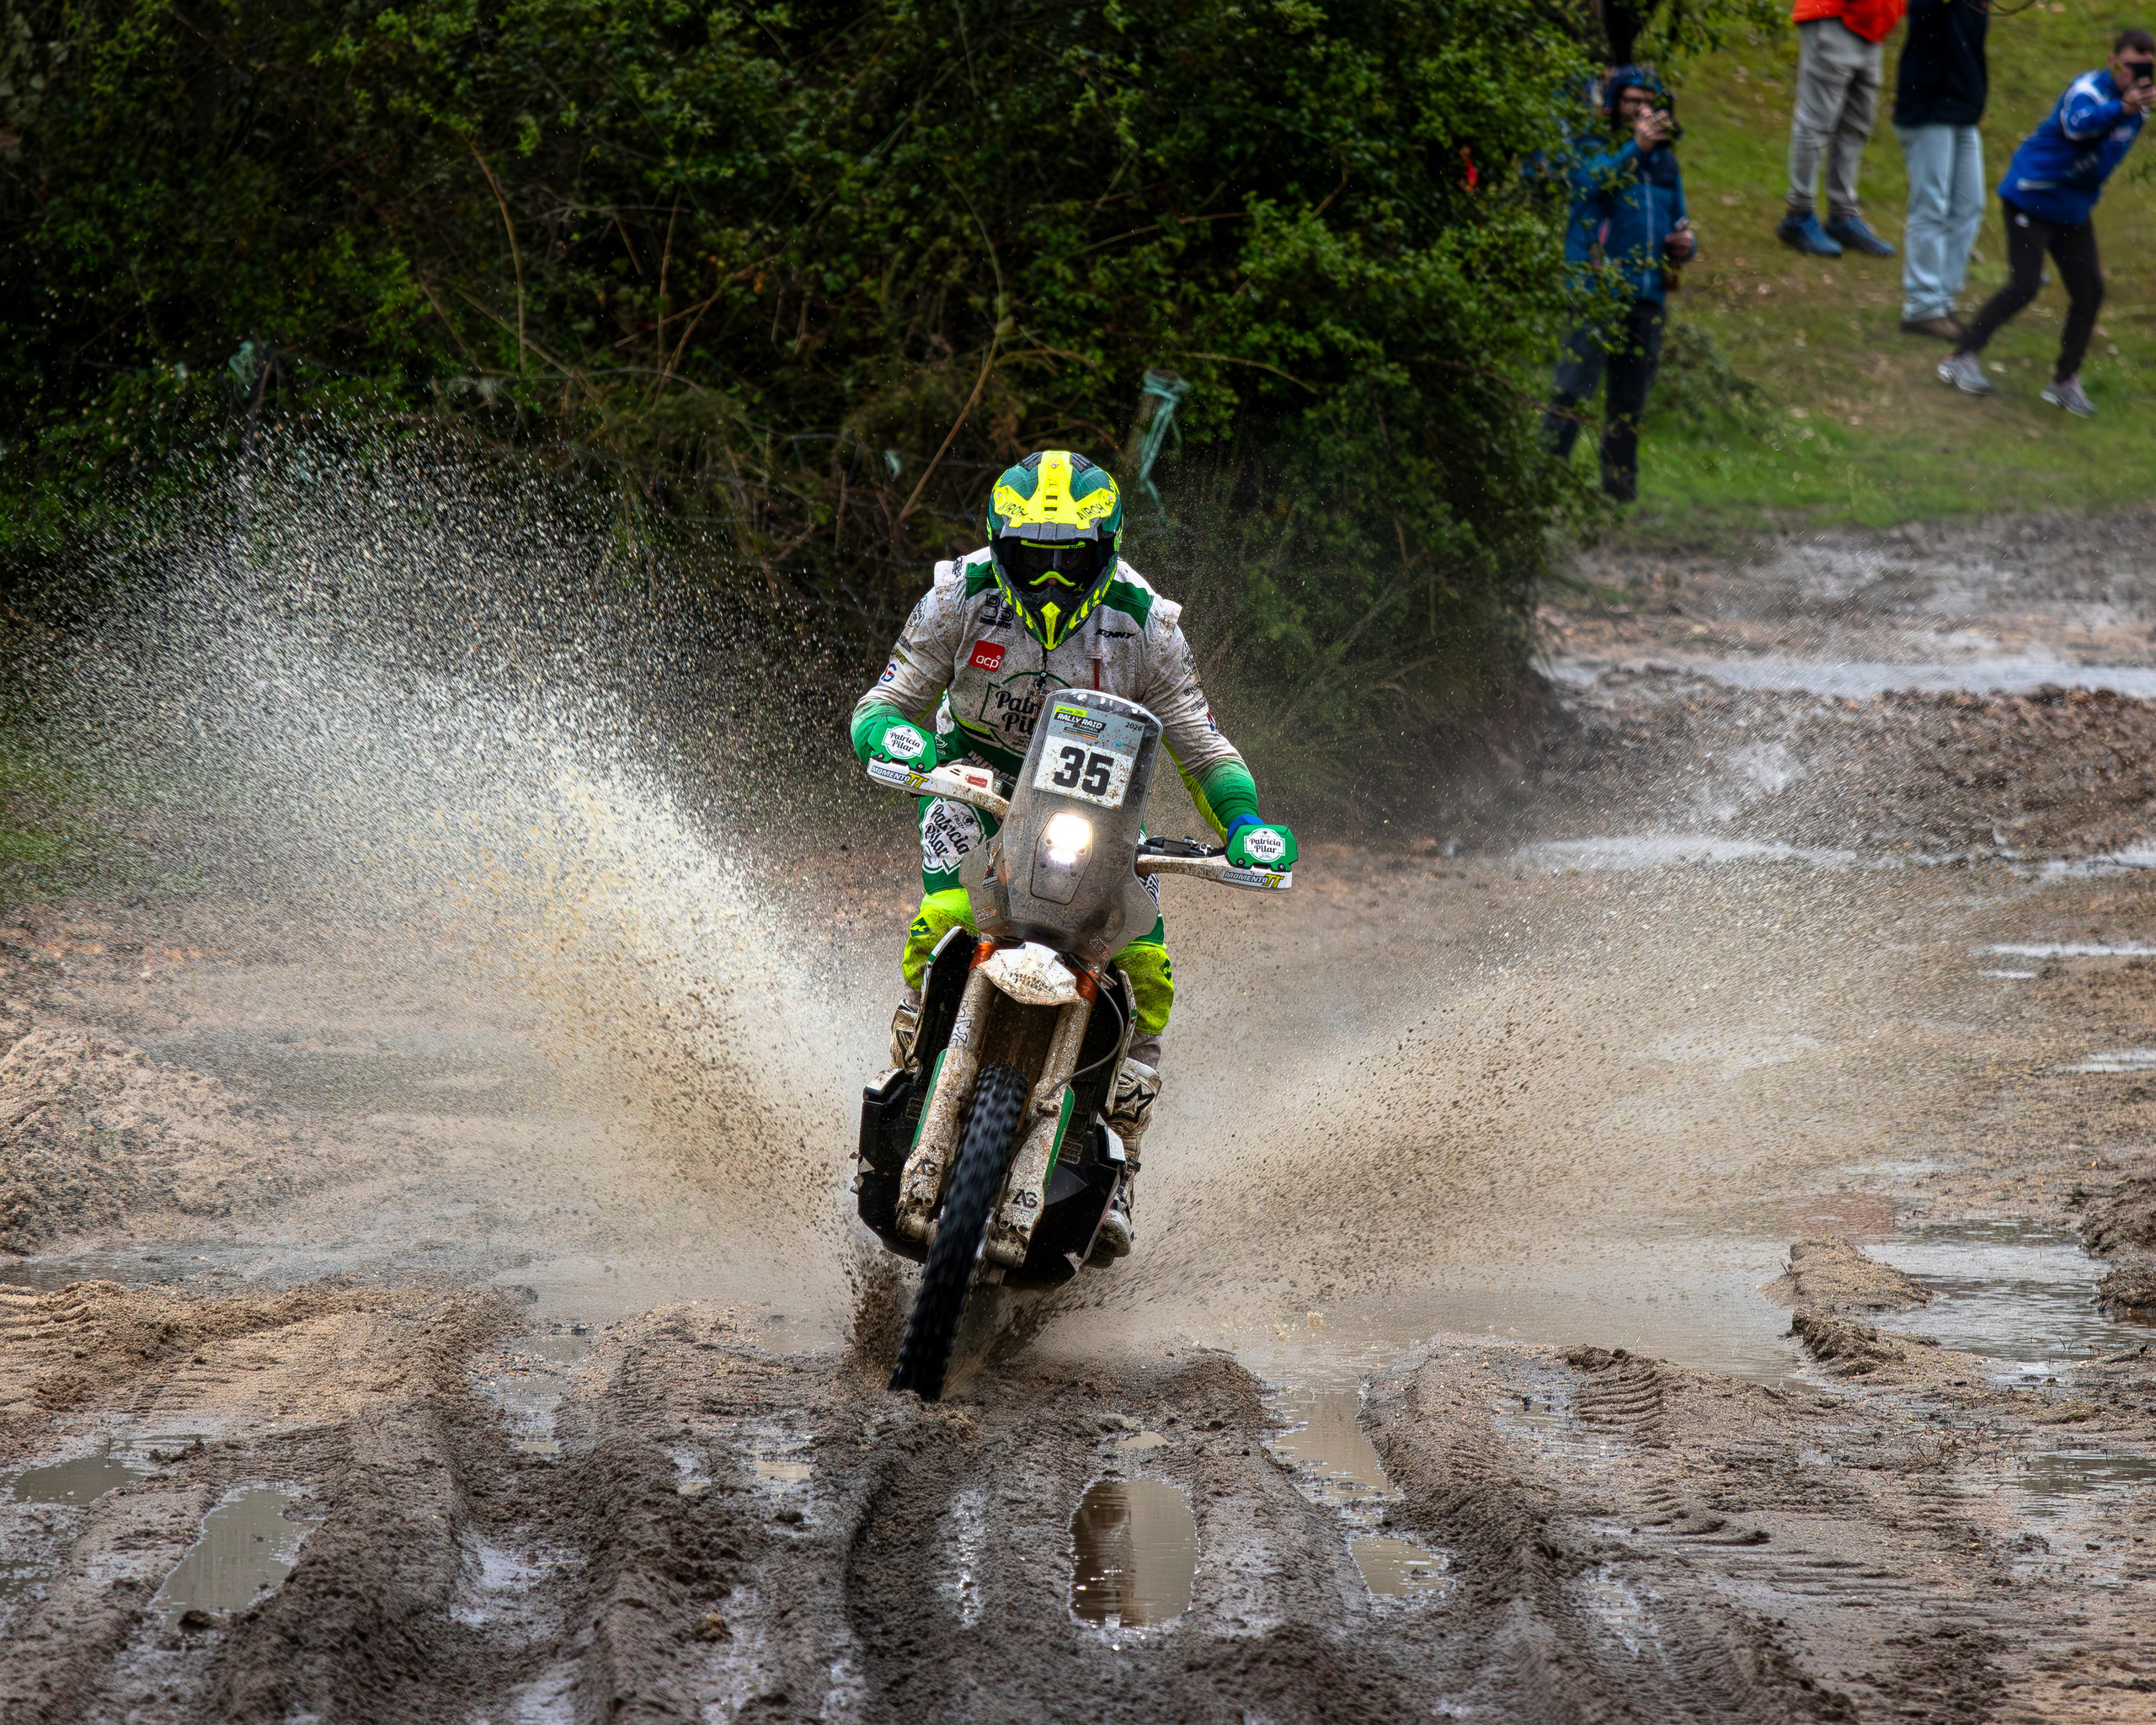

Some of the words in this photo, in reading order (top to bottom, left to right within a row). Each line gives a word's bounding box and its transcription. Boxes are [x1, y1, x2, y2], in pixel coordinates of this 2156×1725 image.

[975, 654, 1000, 669] acp
[995, 691, 1038, 714] Patr
[1001, 712, 1037, 735] Pil
[1057, 713, 1081, 724] RALLY
[1081, 718, 1102, 729] RAID
[1124, 721, 1144, 732] 2026
[889, 731, 921, 749] Patricia
[891, 740, 914, 752] Pilar
[871, 766, 910, 782] MOMENTO
[1054, 745, 1114, 796] 35
[931, 804, 969, 855] Patricia
[925, 822, 949, 858] Pilar
[1249, 837, 1281, 847] Patricia
[1254, 845, 1277, 853] Pilar
[1224, 871, 1268, 884] MOMENTO
